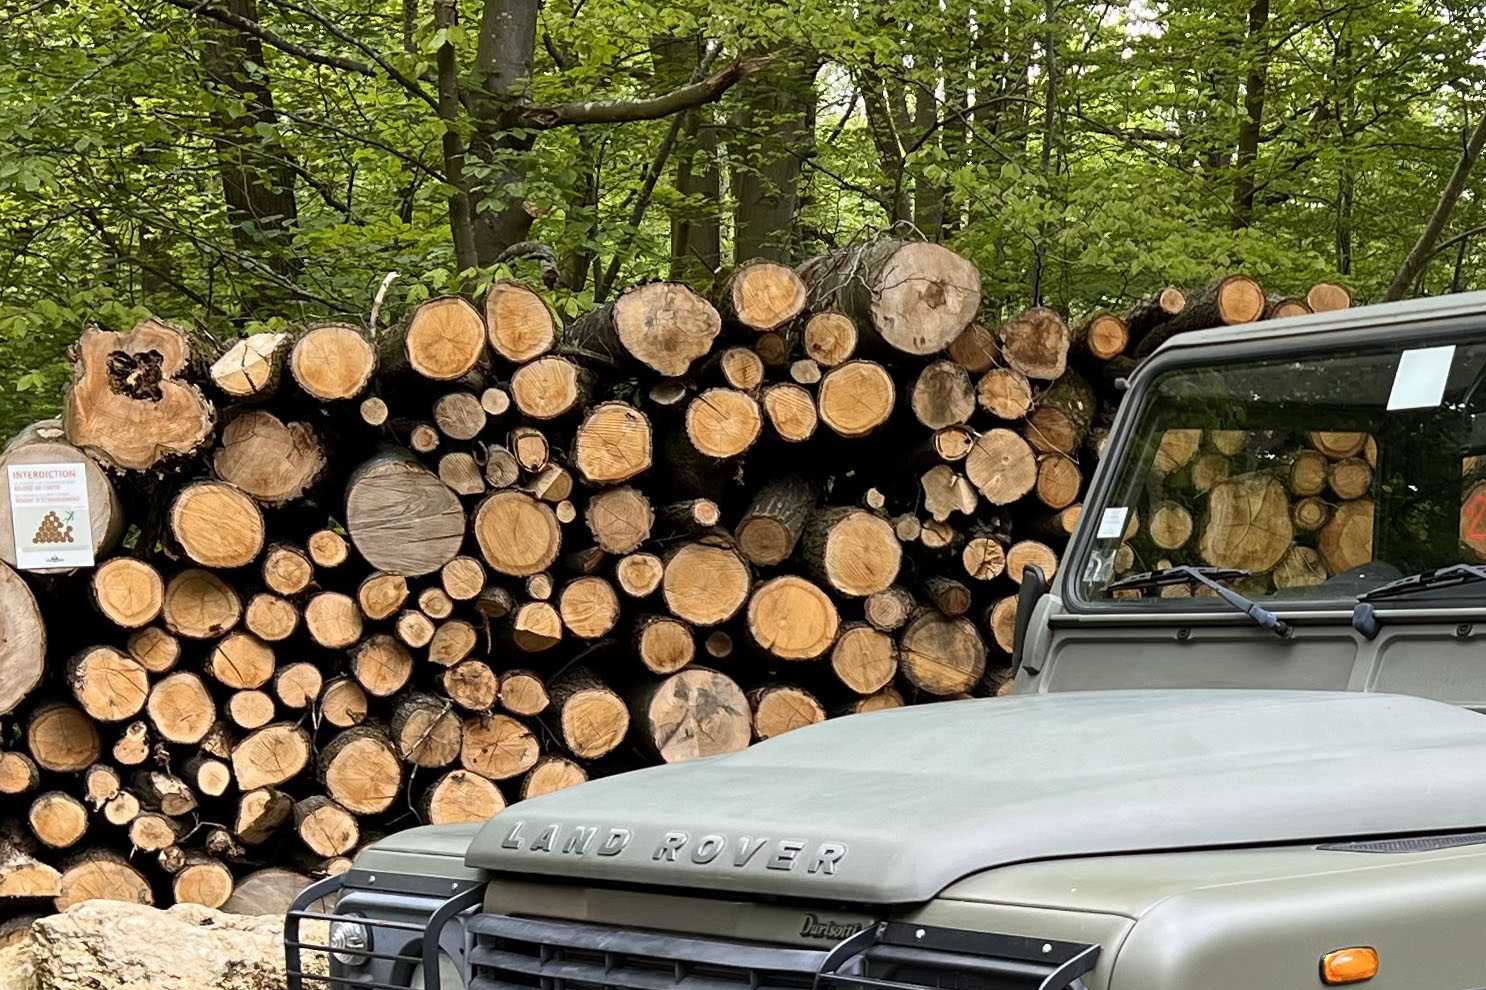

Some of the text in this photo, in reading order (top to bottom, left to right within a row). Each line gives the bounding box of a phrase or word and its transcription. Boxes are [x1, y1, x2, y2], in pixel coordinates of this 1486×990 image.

[13, 469, 76, 479] INTERDICTION
[501, 821, 849, 876] LAND ROVER
